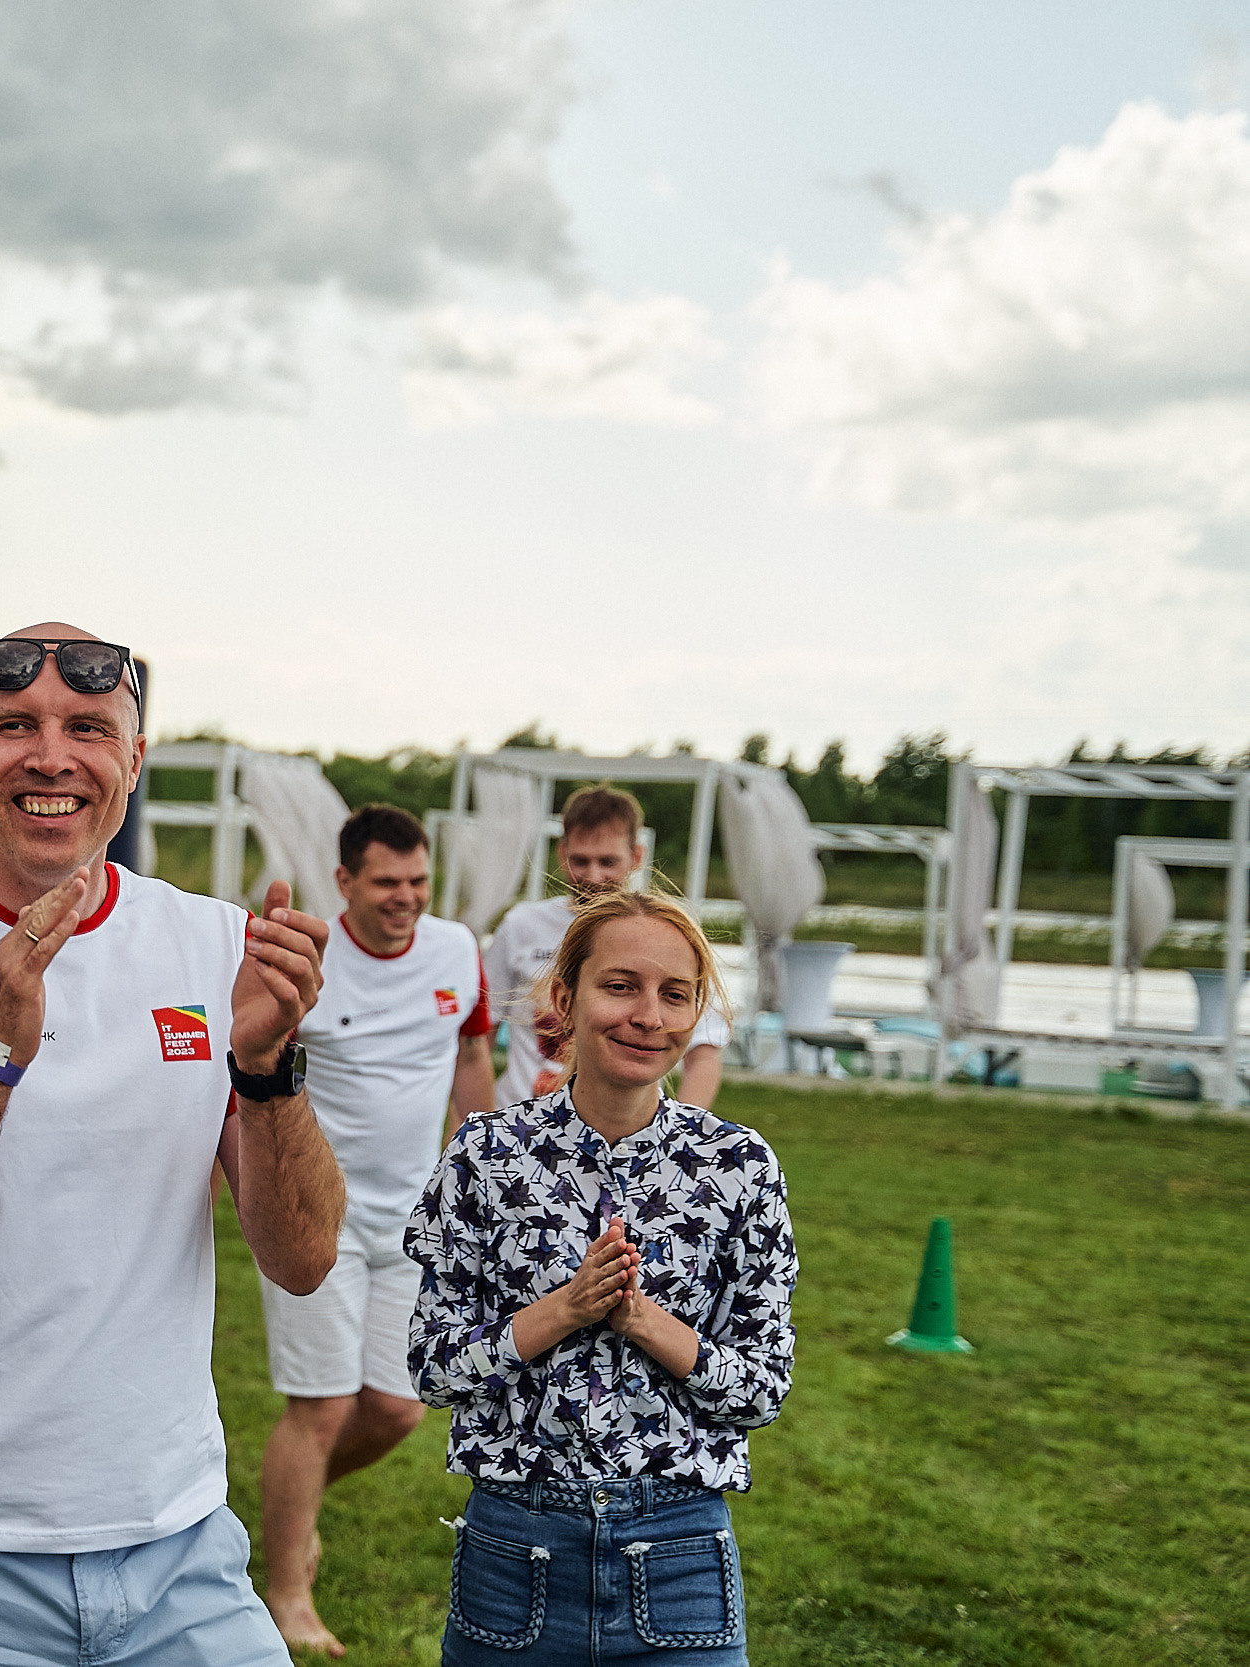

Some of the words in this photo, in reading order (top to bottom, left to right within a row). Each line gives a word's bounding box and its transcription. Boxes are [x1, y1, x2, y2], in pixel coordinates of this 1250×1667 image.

[163, 1031, 206, 1040] SUMMER
[164, 1040, 192, 1048] FEST
[166, 1047, 196, 1056] 2023
